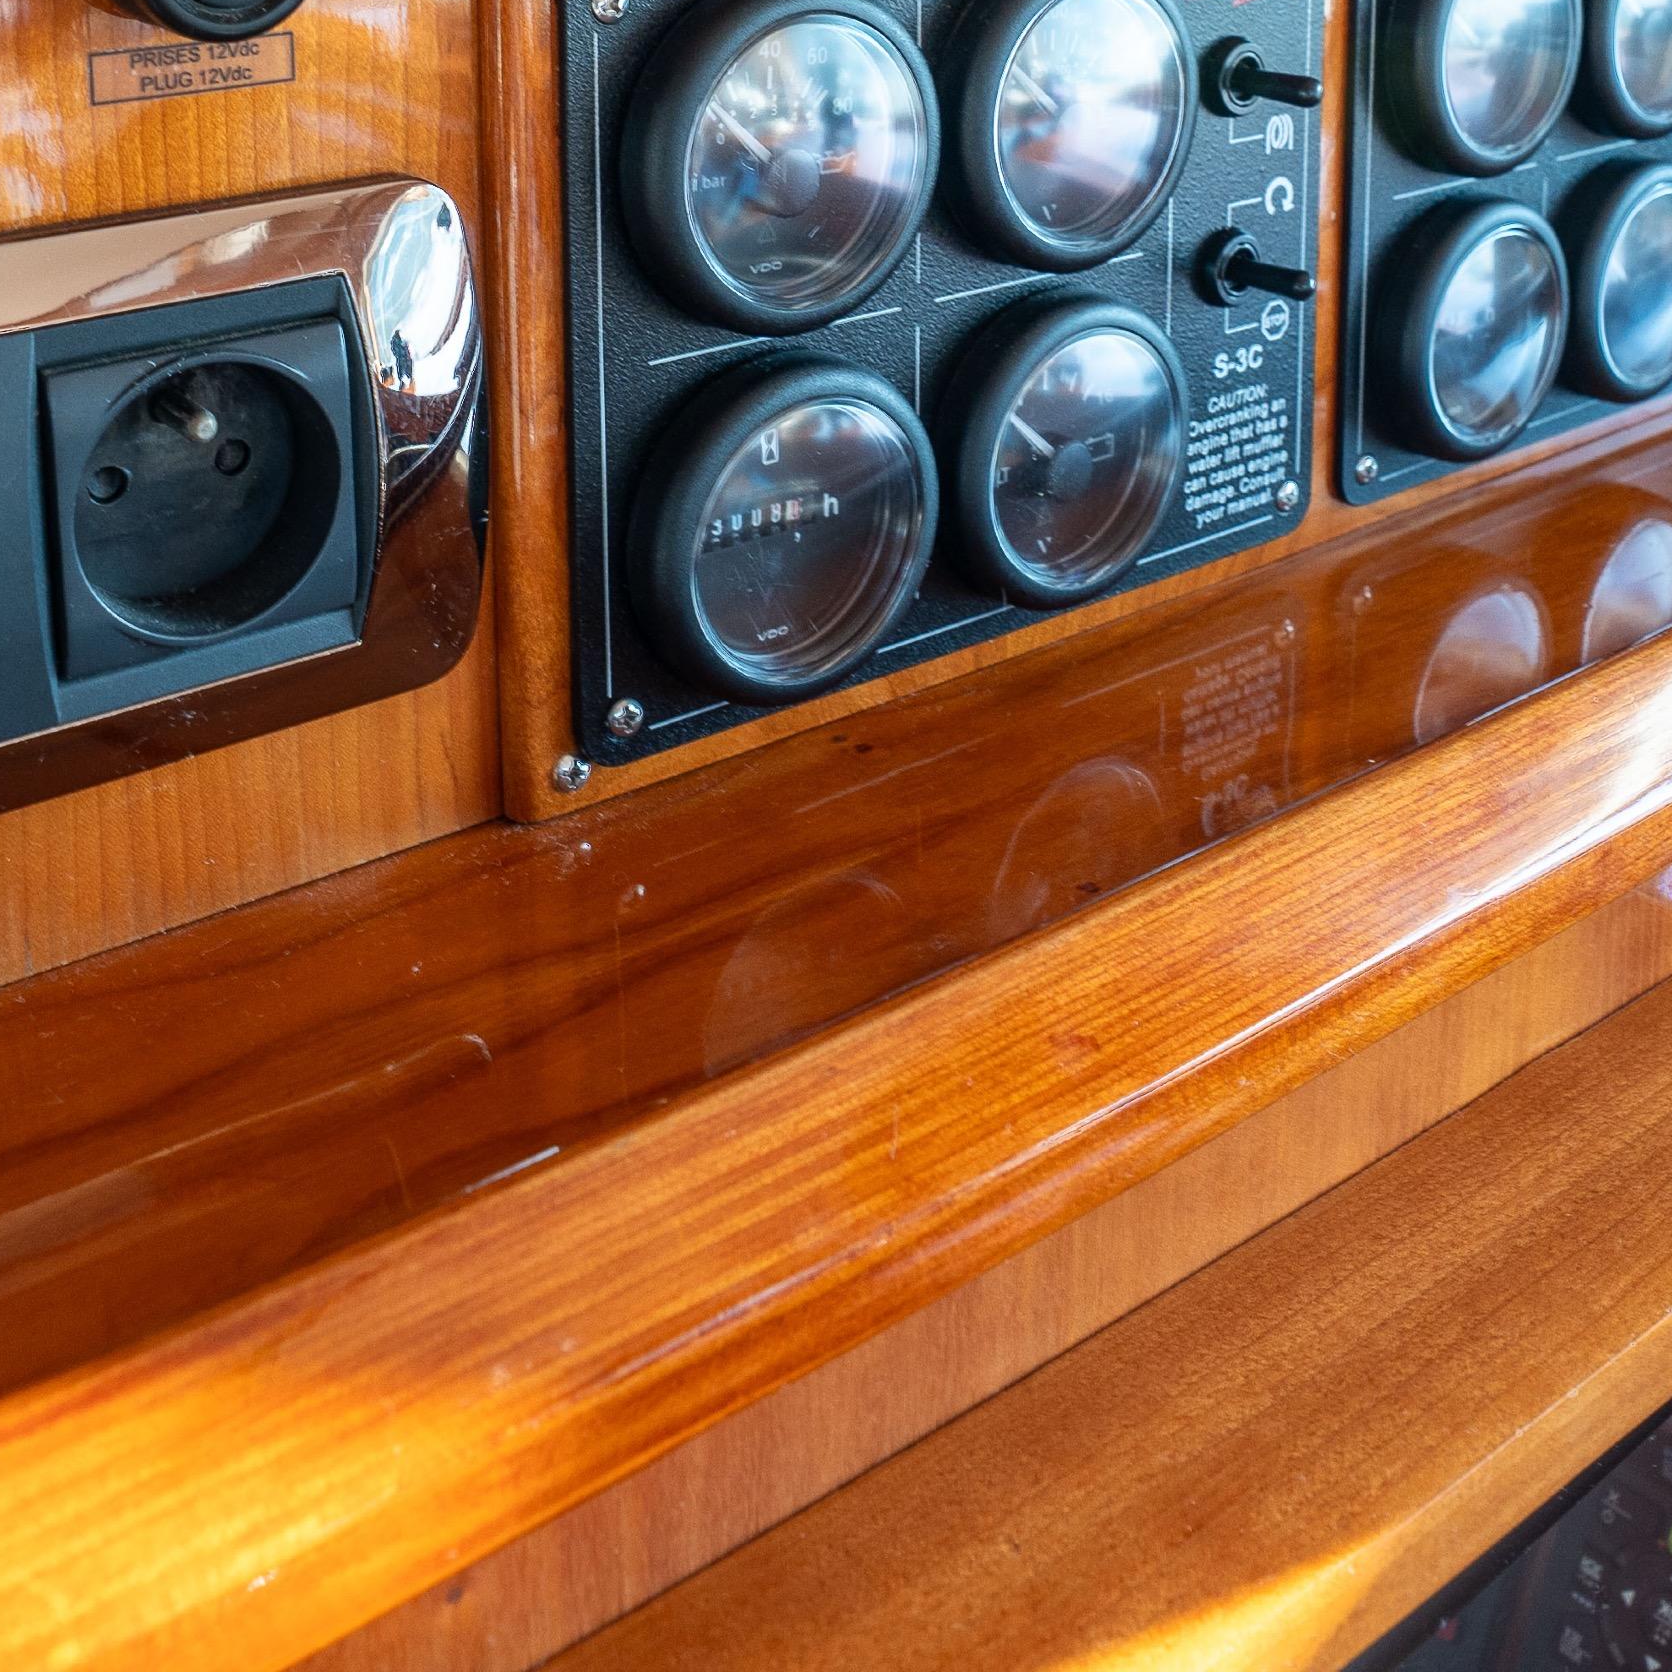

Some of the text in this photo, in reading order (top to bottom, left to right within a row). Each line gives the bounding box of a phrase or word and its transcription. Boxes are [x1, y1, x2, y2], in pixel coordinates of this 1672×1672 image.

[129, 41, 260, 70] PRISES 12Vdc
[759, 40, 781, 59] 40
[140, 66, 253, 93] PLUG 12Vdc
[703, 175, 726, 190] bar
[1213, 343, 1263, 378] S-3C
[1208, 383, 1269, 413] CAUTION:
[1271, 398, 1287, 412] an
[1230, 423, 1253, 444] that
[1255, 417, 1278, 435] has
[1189, 452, 1223, 475] water
[1242, 433, 1284, 458] muffler
[1184, 450, 1288, 495] can cause engine
[1239, 466, 1286, 494] Consult
[823, 492, 839, 517] h
[1195, 505, 1225, 529] your
